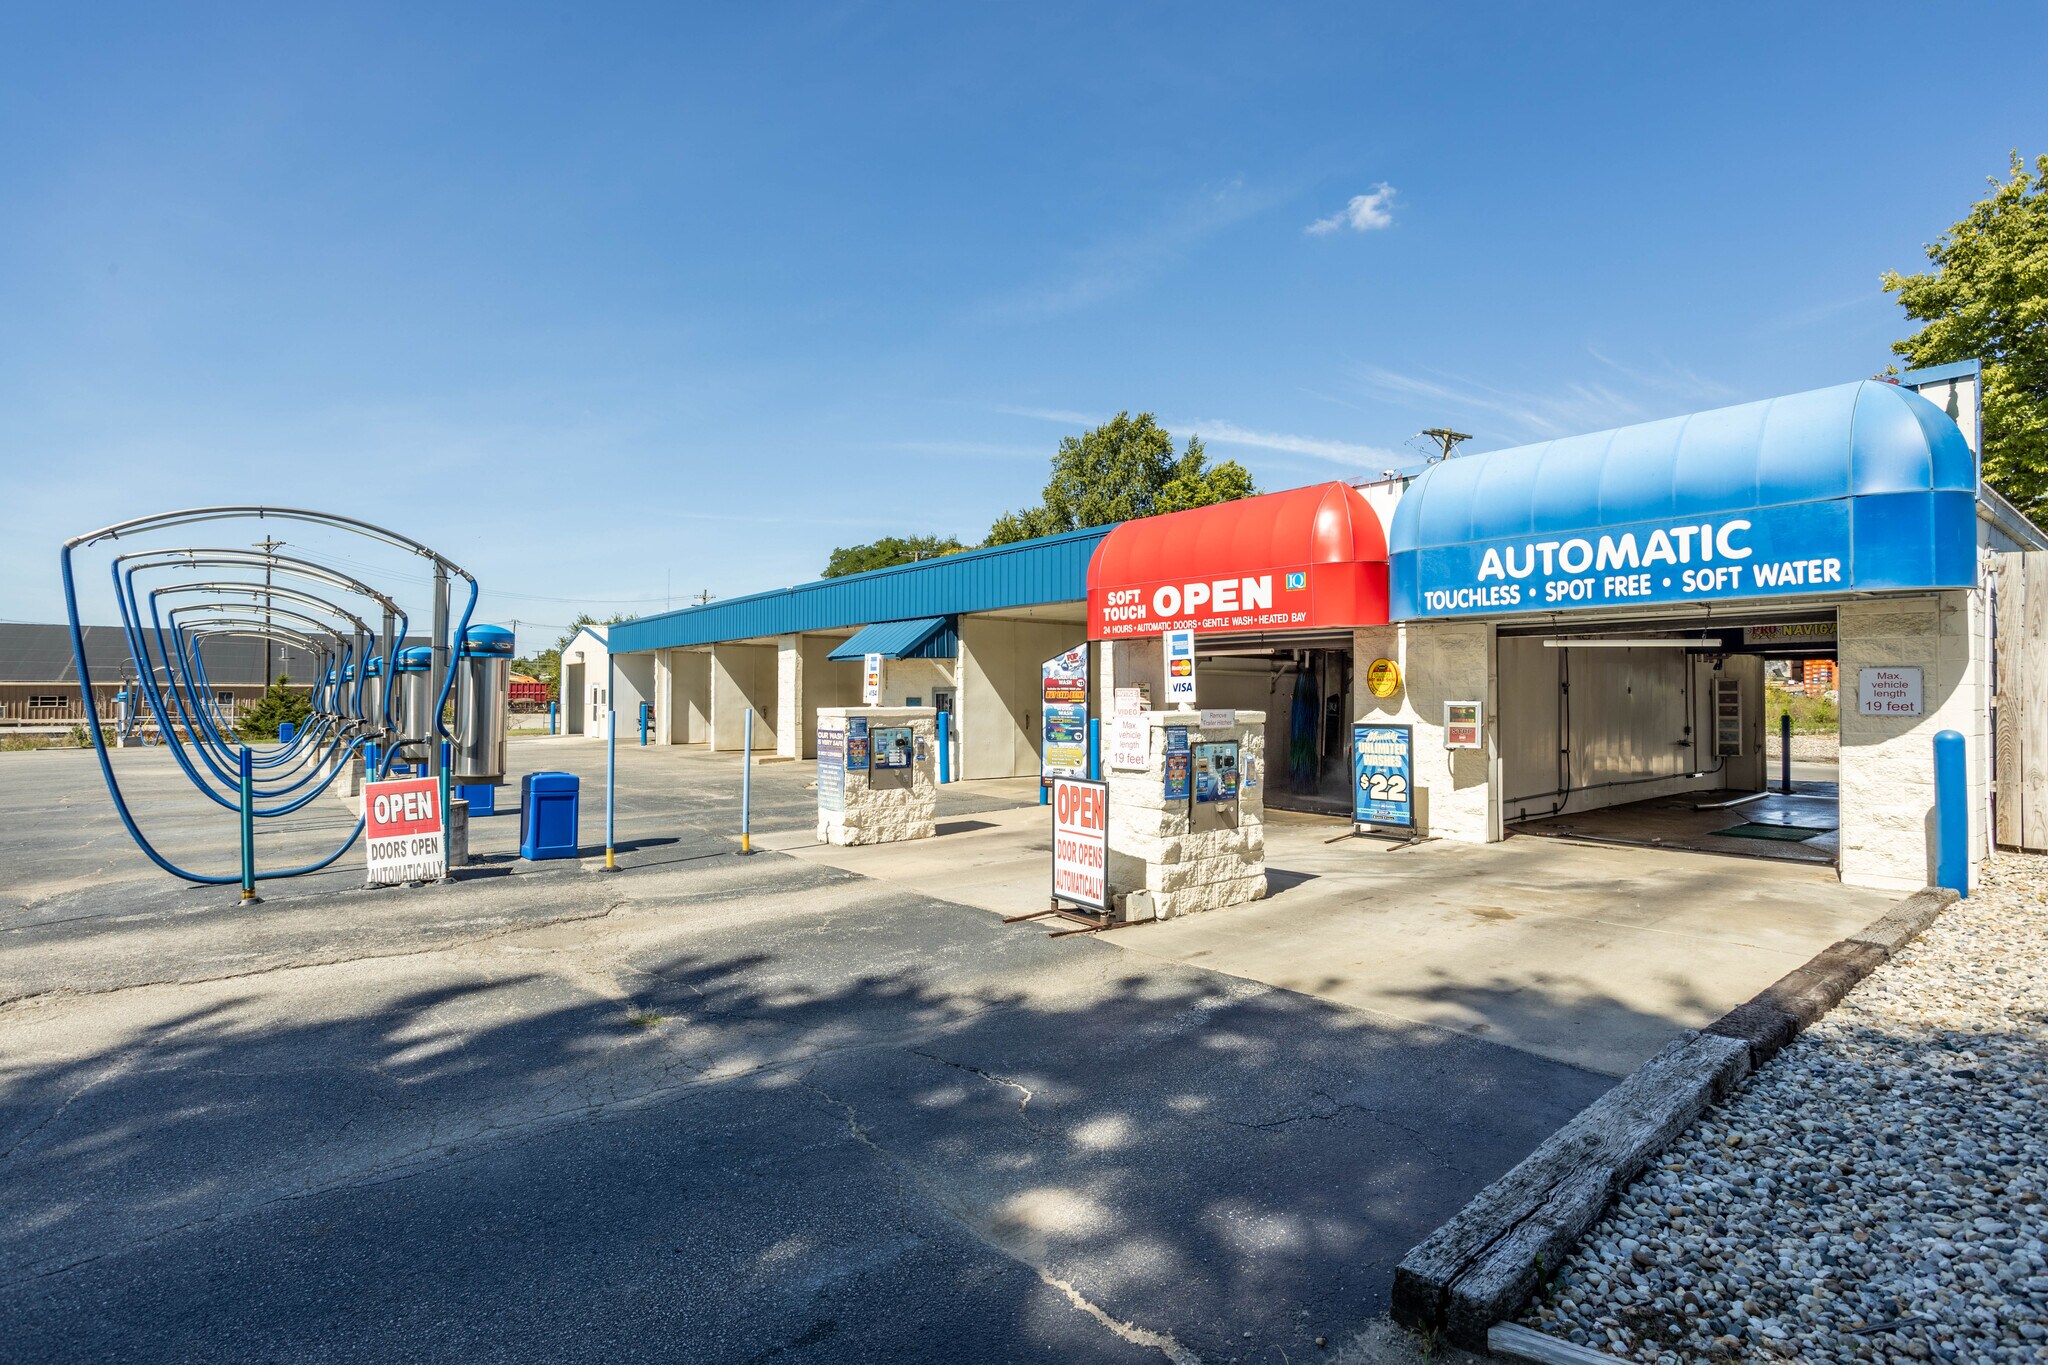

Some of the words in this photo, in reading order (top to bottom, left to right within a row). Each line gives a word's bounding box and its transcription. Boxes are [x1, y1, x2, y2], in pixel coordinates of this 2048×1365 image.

[1477, 519, 1752, 581] AUTOMATIC
[1288, 573, 1304, 589] IQ
[1424, 584, 1520, 610] TOUCHLESS
[1545, 578, 1595, 602] SPOT
[1604, 573, 1652, 598] FREE
[1682, 566, 1742, 592] SOFT
[1753, 558, 1841, 588] WATER
[1108, 589, 1141, 605] SOFT
[1153, 575, 1272, 617] OPEN
[1103, 605, 1146, 622] TOUCH
[1103, 626, 1111, 634] 24
[1112, 624, 1133, 633] HOURS
[1137, 621, 1171, 632] AUTOMATIC
[1174, 620, 1197, 629] DOORS
[1202, 617, 1229, 628] GENTLE
[1232, 616, 1253, 626] WASH
[1259, 614, 1288, 624] HEATED
[1291, 612, 1306, 622] BAY
[1782, 623, 1837, 636] NAVIGA
[1877, 672, 1902, 680] Max.
[1172, 682, 1193, 692] VISA
[1873, 690, 1906, 699] length
[1118, 708, 1138, 716] VIDEO
[1866, 701, 1882, 711] 19
[1887, 701, 1914, 711] feet
[1119, 731, 1141, 739] vehicle
[1120, 741, 1139, 750] length
[1358, 742, 1406, 755] UNLIMITED
[1114, 752, 1124, 763] 19
[1127, 753, 1144, 765] feet
[1363, 754, 1402, 767] WASHES
[1360, 773, 1407, 802] $22
[374, 790, 433, 824] OPEN
[1057, 783, 1104, 830] OPEN
[371, 840, 407, 860] DOORS
[411, 837, 438, 856] OPEN
[1057, 839, 1077, 863] DOOR
[1079, 843, 1103, 869] OPENS
[370, 860, 443, 883] AUTOMATICALLY
[1056, 868, 1104, 900] AUTOMATICALLY
